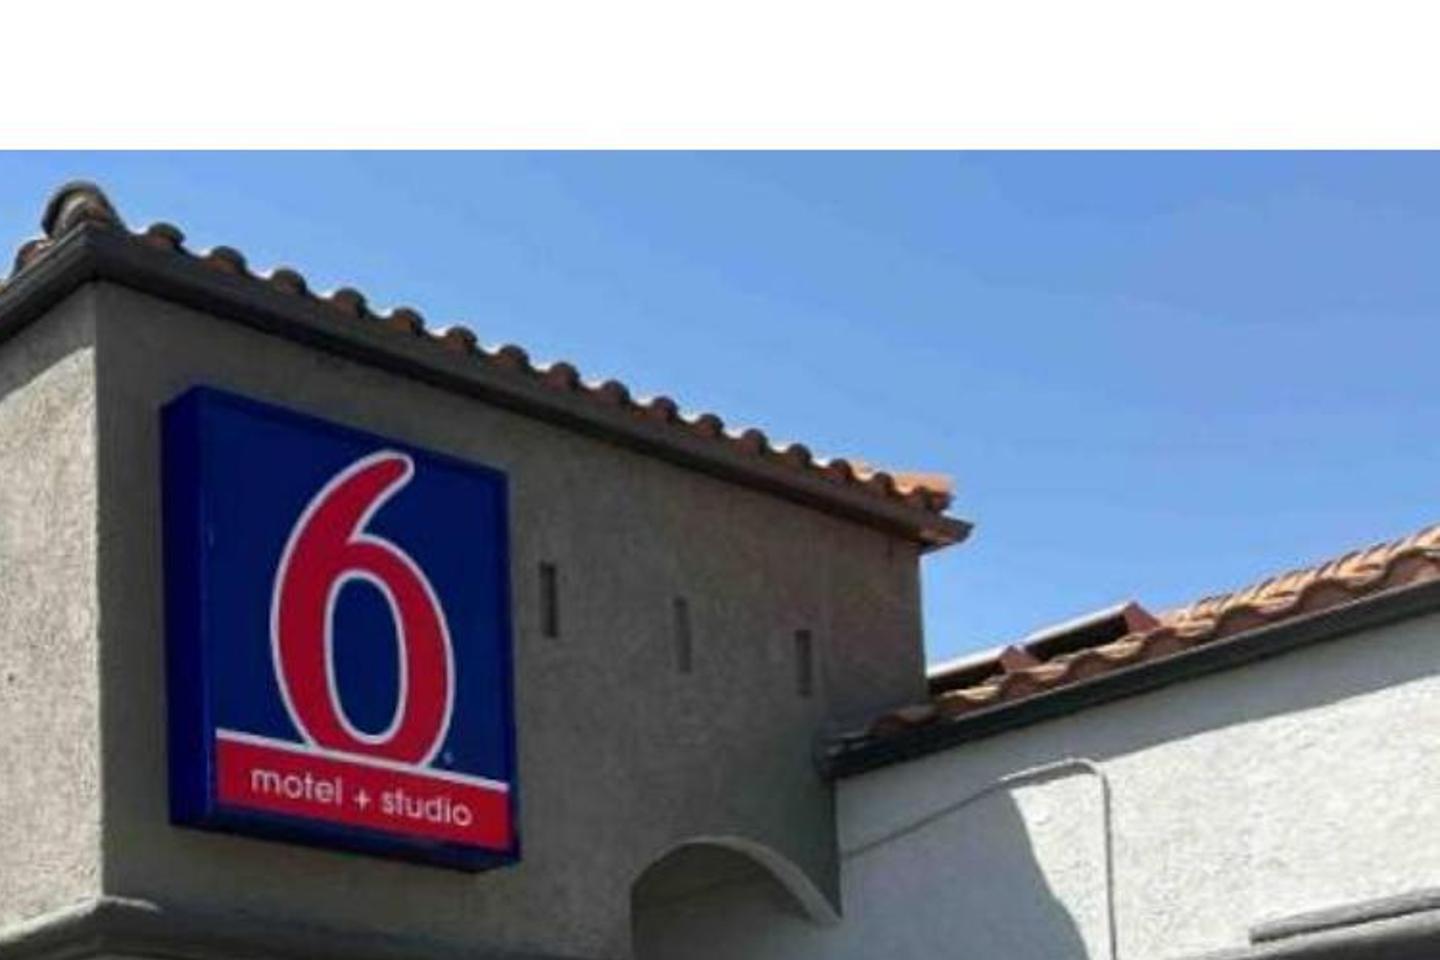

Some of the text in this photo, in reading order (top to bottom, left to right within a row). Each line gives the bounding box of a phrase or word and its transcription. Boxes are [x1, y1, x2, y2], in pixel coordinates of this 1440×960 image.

[271, 450, 455, 768] 6
[251, 768, 342, 806] motel
[381, 788, 472, 826] studio
